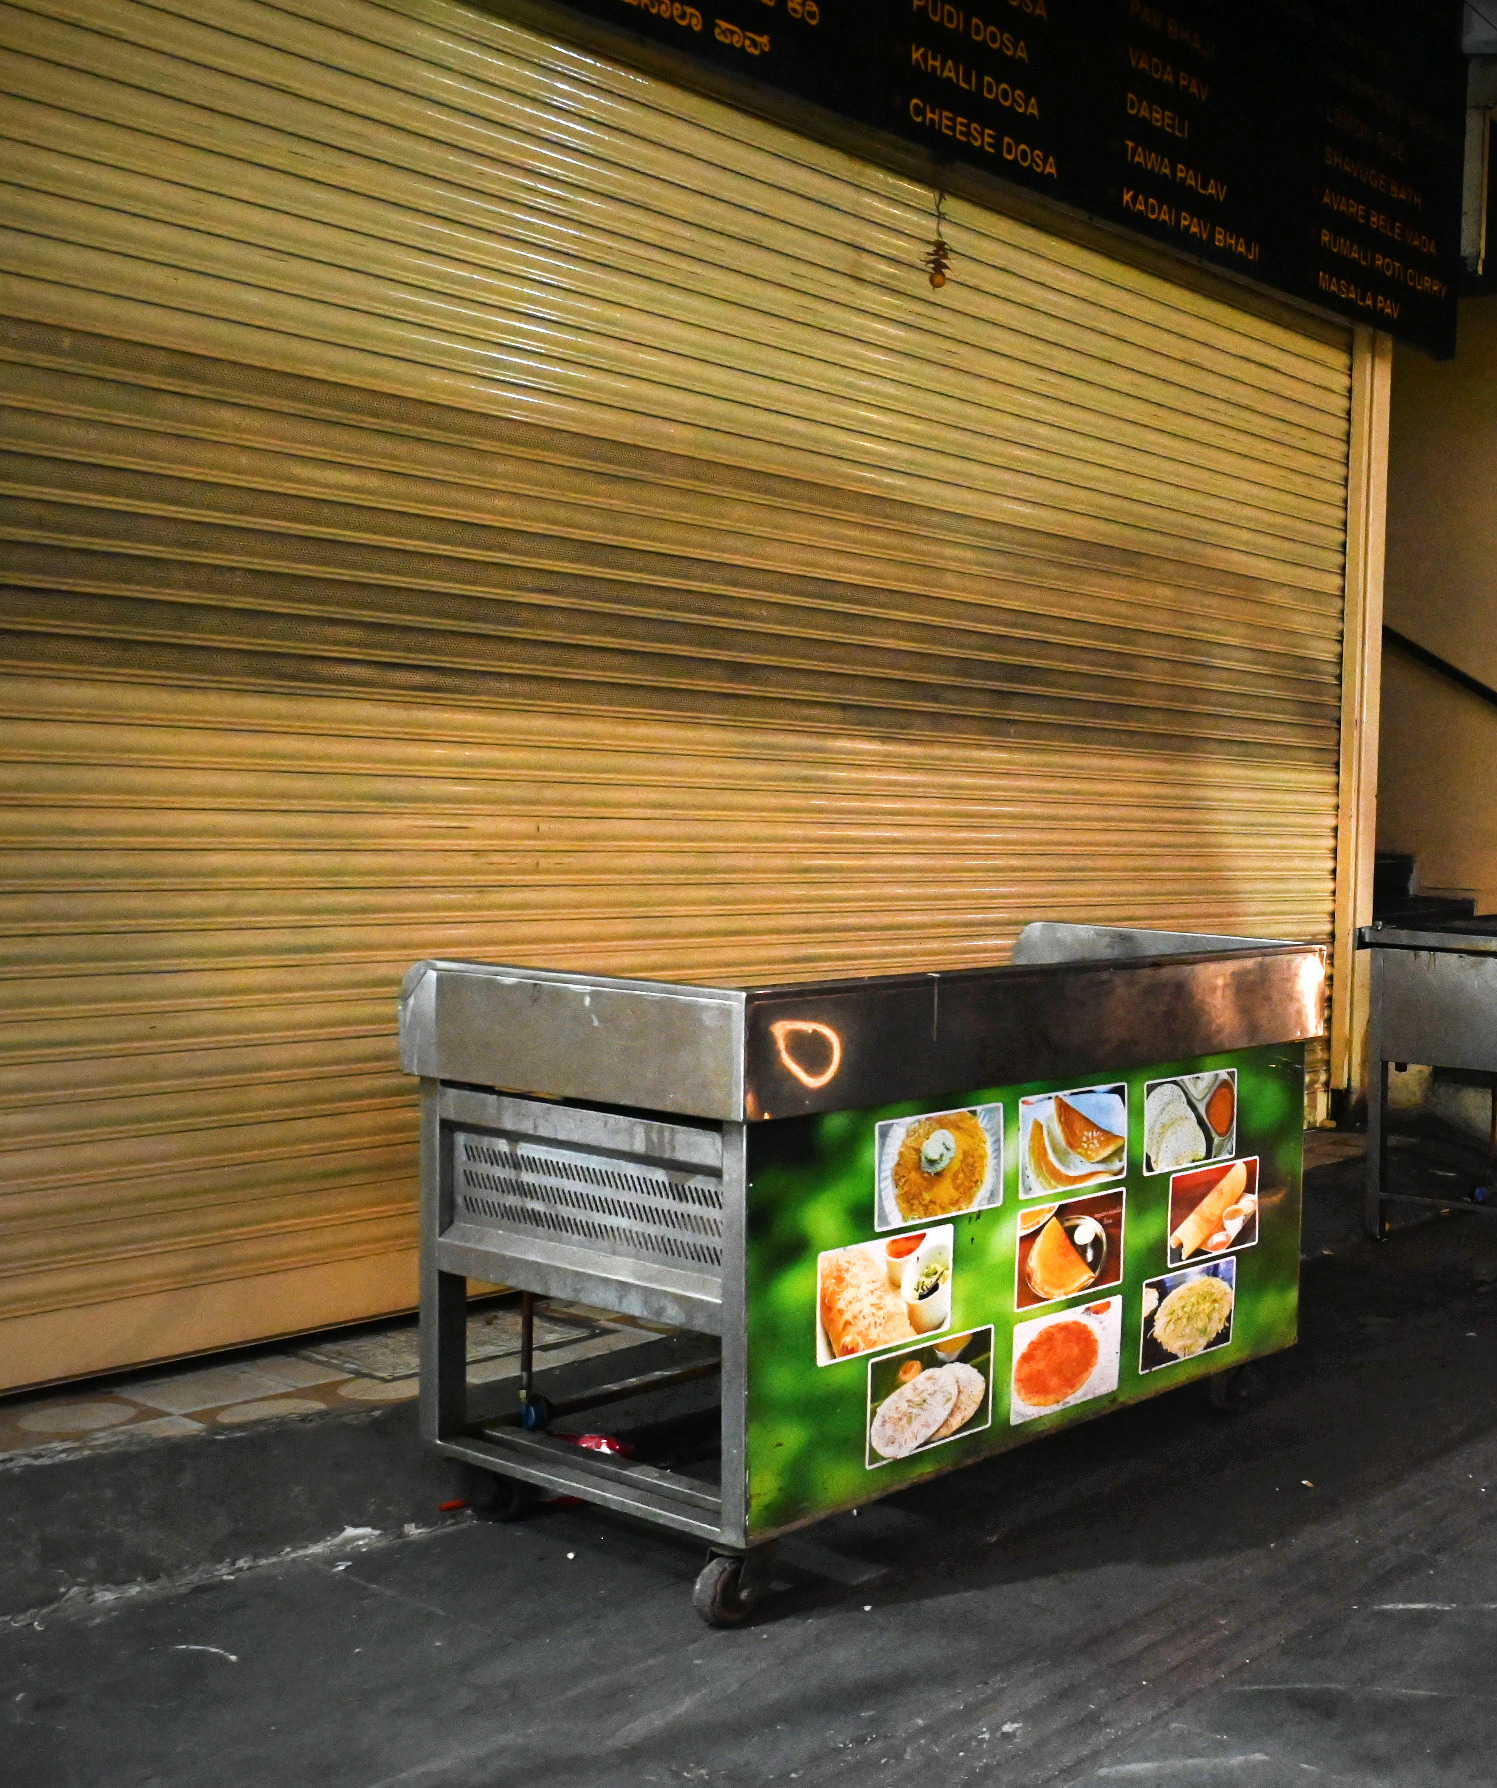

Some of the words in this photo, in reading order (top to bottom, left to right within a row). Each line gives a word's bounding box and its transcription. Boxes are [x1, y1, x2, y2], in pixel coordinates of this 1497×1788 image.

[913, 0, 963, 33] PUDI
[971, 17, 1029, 64] DOSA
[911, 43, 976, 92] KHALI
[983, 75, 1040, 120] DOSA
[1128, 46, 1175, 85] VADA
[1179, 72, 1209, 102] PAV
[909, 97, 996, 153] CHEESE
[1003, 136, 1058, 179] DOSA
[1126, 92, 1188, 140] DABELI
[1124, 139, 1172, 179] TAWA
[1177, 163, 1229, 203] PALAV
[1324, 145, 1387, 193] SHAVUGE
[1390, 180, 1422, 211] BATH
[1122, 187, 1176, 227] KADAI
[1180, 211, 1210, 241] PAV
[1215, 225, 1261, 263] BHAJI
[1322, 188, 1366, 223] AVARE
[1370, 209, 1402, 241] BELE
[1406, 226, 1438, 257] VADA
[1318, 270, 1373, 310] MASALA
[1377, 295, 1401, 321] PAV
[1321, 228, 1371, 268] RUMALI
[1375, 253, 1404, 281] ROTI
[1407, 269, 1448, 299] CURRY
